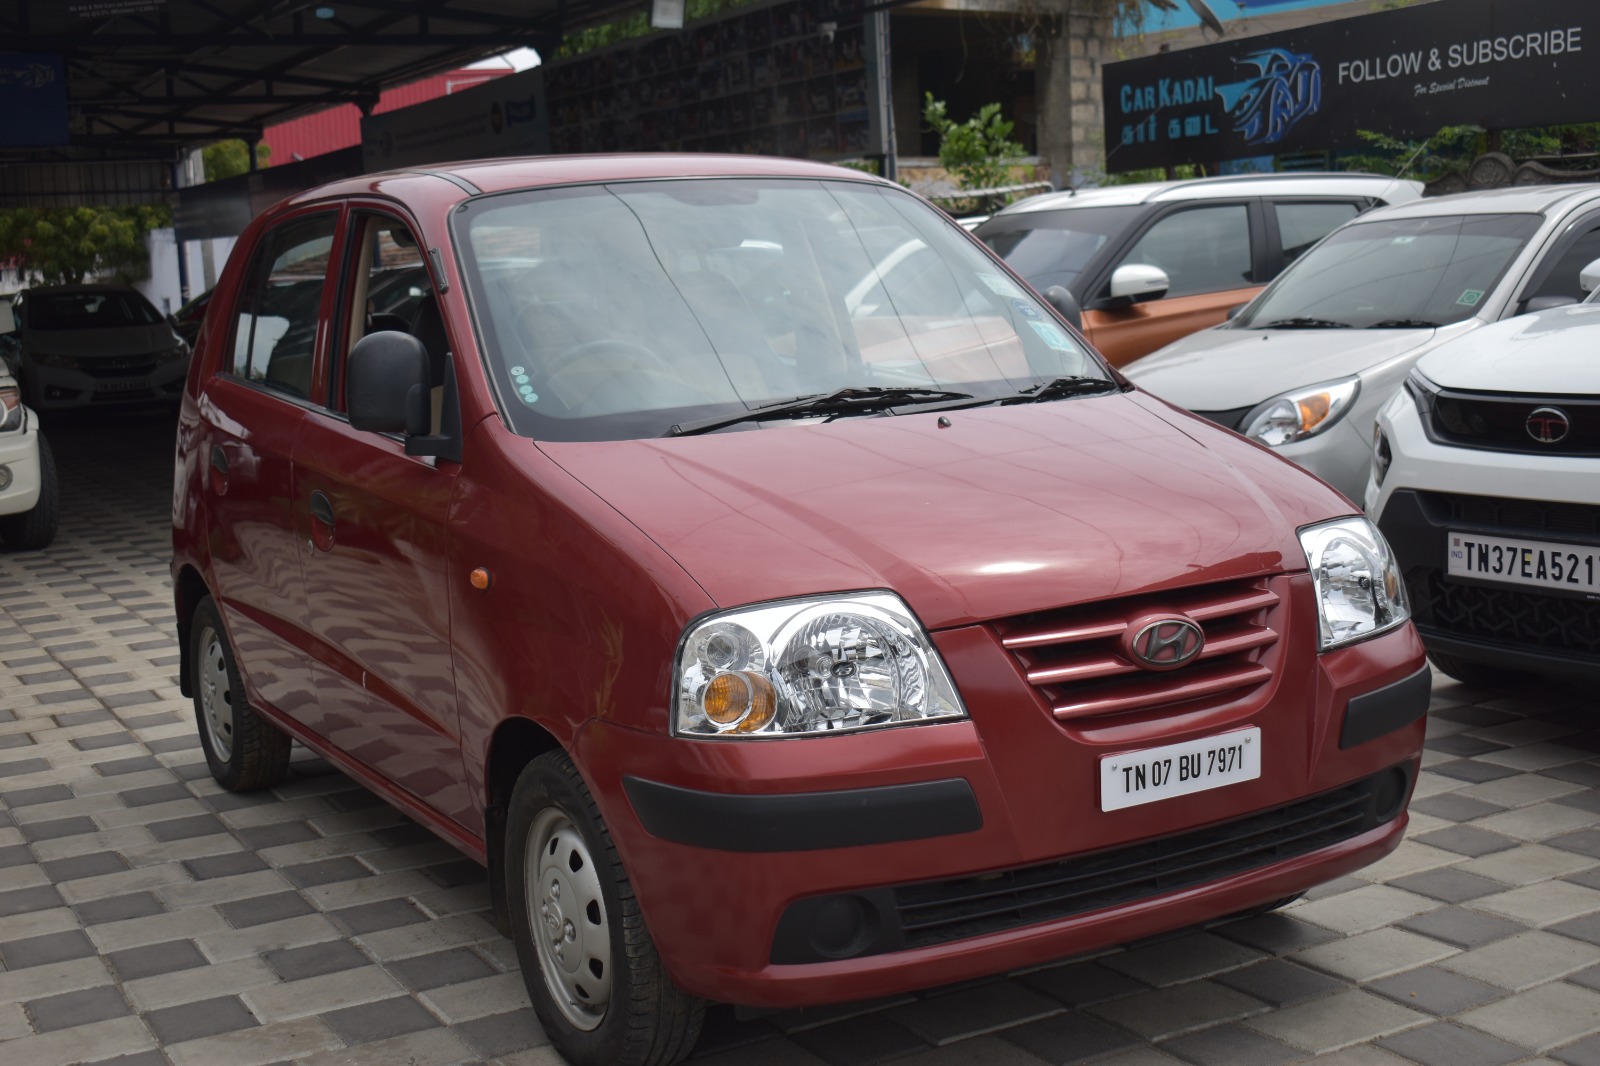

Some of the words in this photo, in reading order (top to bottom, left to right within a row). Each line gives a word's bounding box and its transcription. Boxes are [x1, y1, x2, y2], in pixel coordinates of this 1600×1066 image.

[1338, 51, 1422, 85] FOLLOW
[1427, 48, 1442, 72] &
[1448, 27, 1582, 68] SUBSCRIBE
[1464, 541, 1600, 587] TN37EA521
[1122, 764, 1147, 794] TN
[1151, 759, 1172, 788] 07
[1179, 754, 1201, 781] BU
[1207, 745, 1243, 776] 7971
